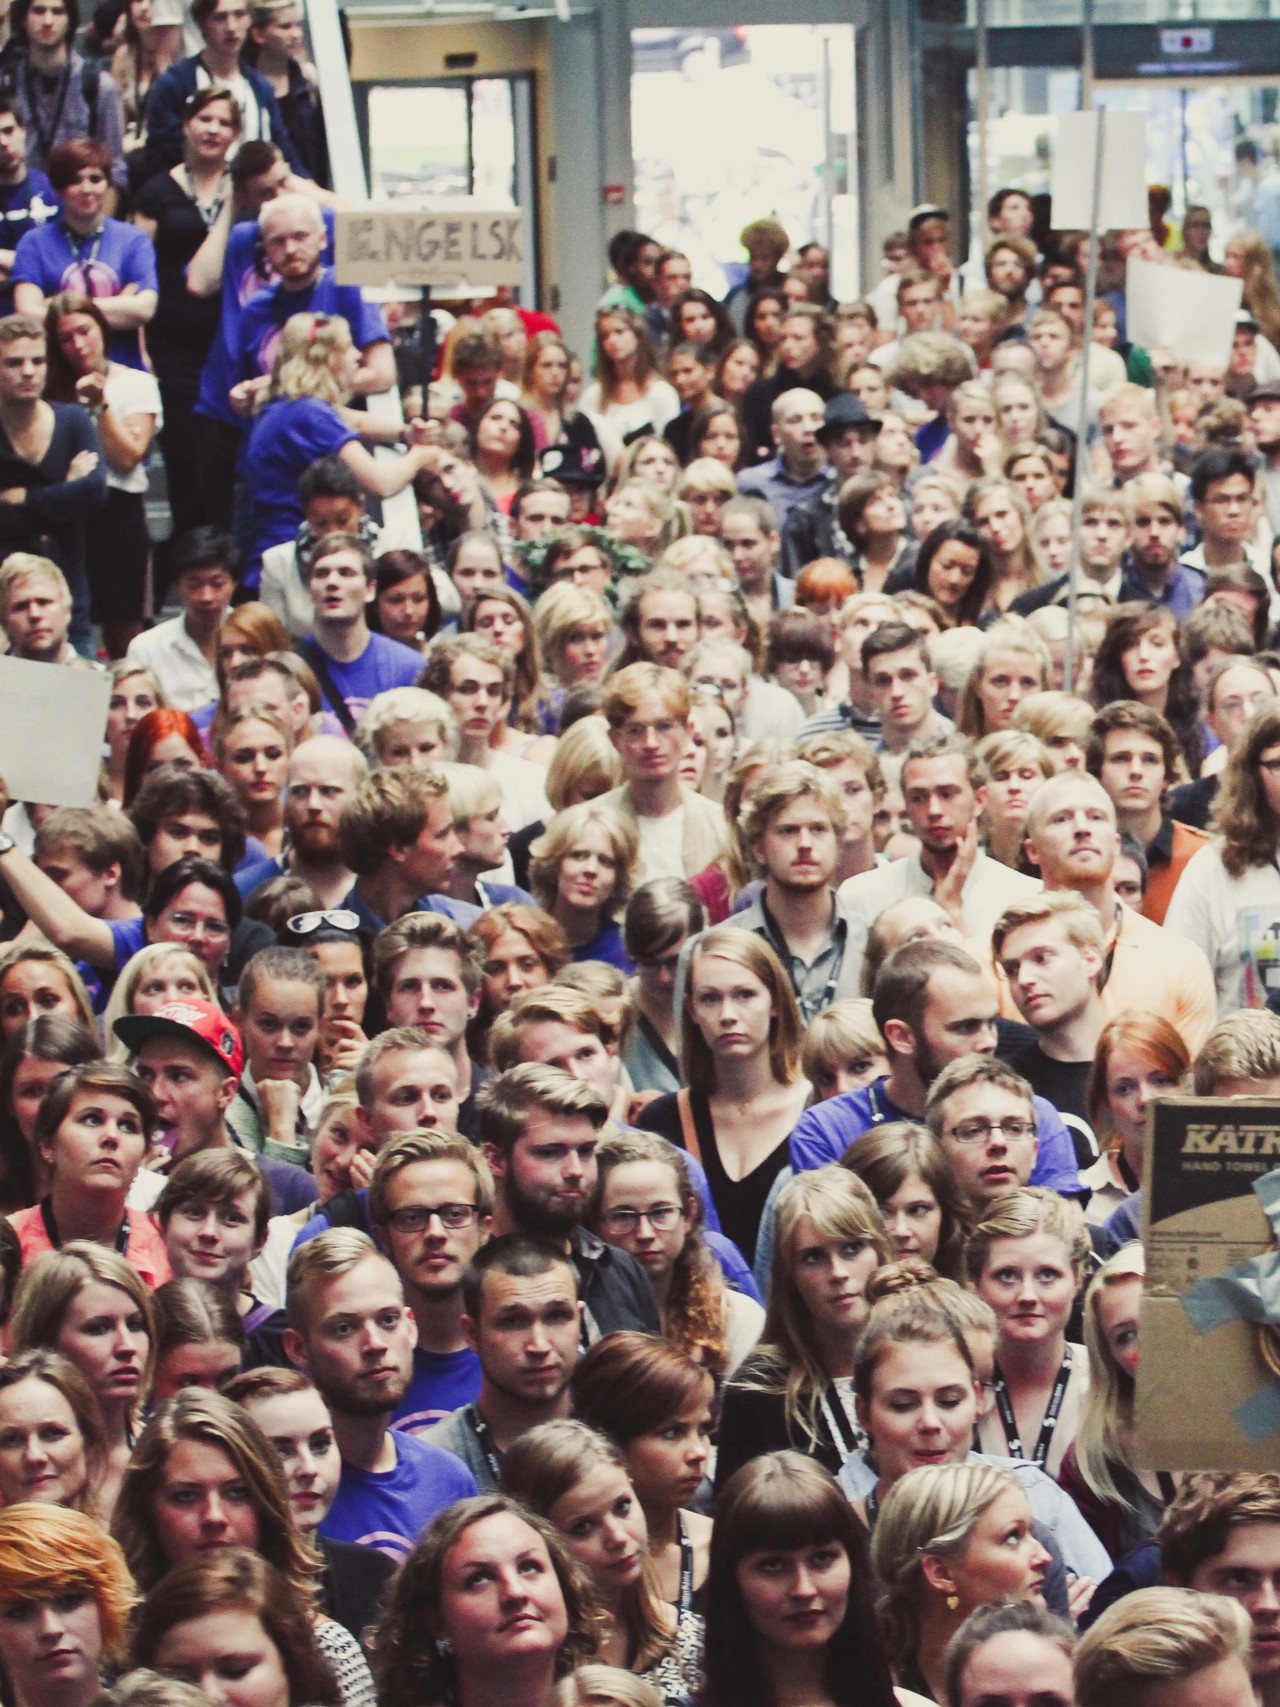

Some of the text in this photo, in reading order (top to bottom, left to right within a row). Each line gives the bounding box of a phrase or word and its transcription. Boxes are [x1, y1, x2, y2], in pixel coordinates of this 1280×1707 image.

[347, 218, 523, 262] ENGELSK
[1182, 1161, 1221, 1172] HAND
[1225, 1161, 1267, 1172] TOWEL
